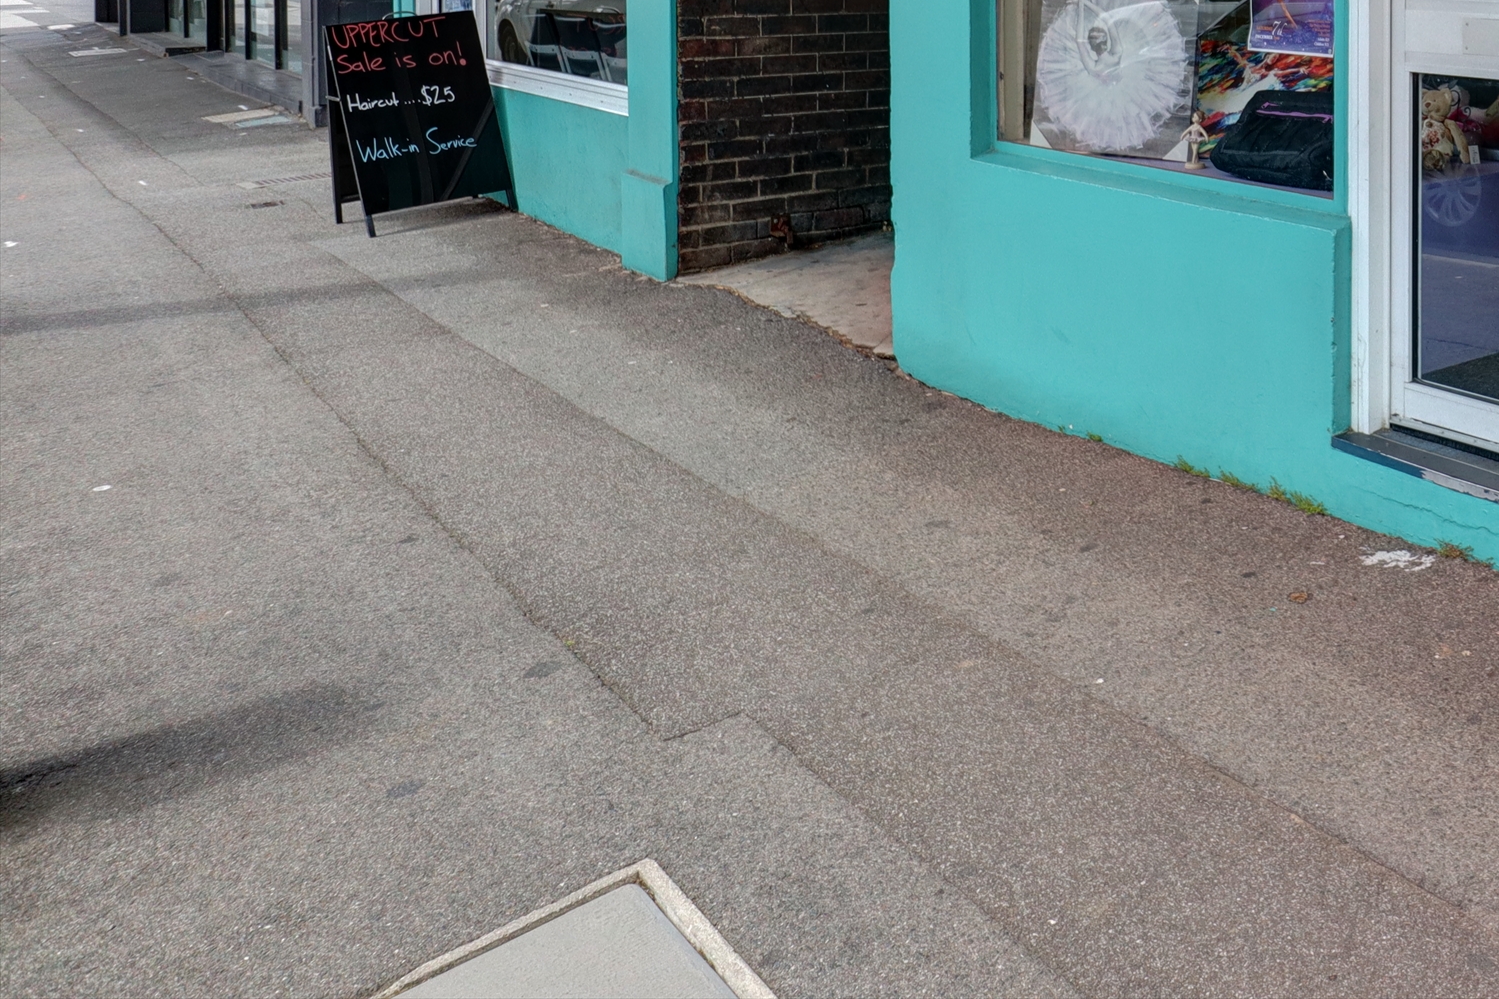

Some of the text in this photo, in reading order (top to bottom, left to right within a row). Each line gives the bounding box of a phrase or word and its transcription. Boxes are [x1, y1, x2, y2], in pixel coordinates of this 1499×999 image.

[331, 16, 446, 49] UPPERCUT
[336, 40, 467, 74] Sale is on!
[346, 91, 400, 112] Haircut
[355, 126, 478, 163] Walk-in Service
